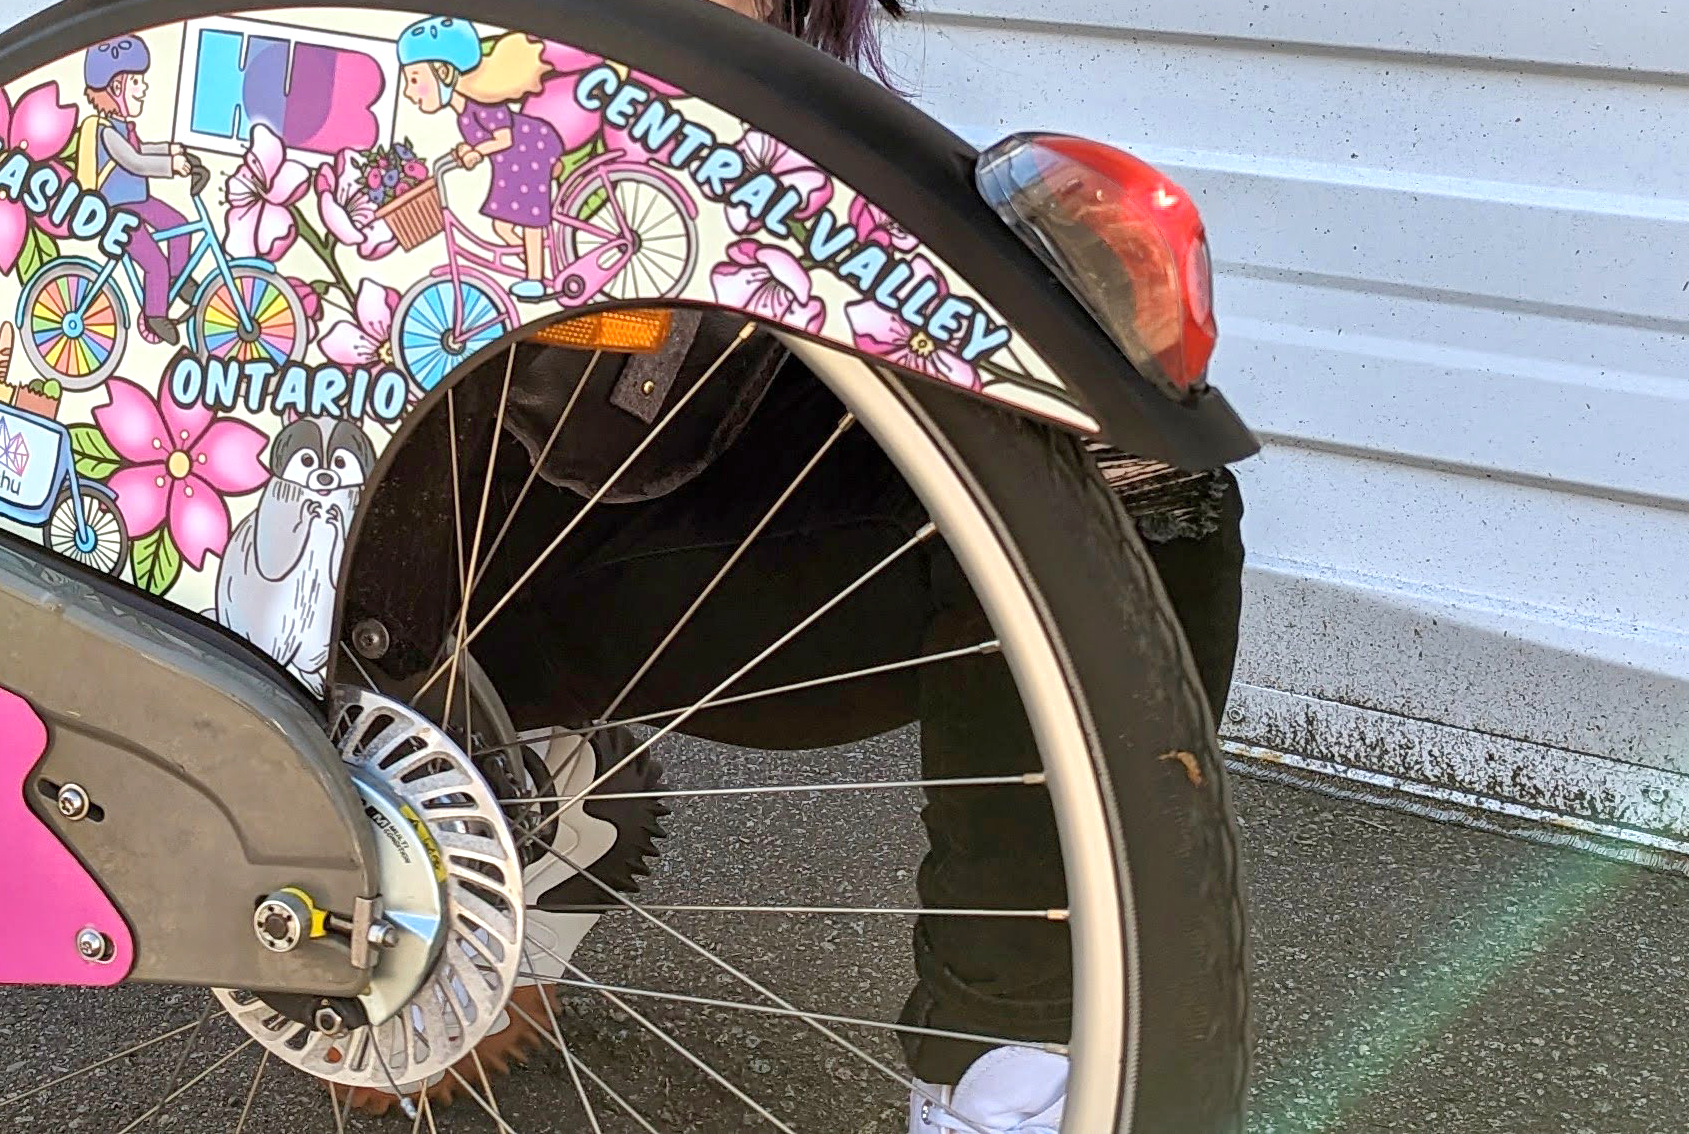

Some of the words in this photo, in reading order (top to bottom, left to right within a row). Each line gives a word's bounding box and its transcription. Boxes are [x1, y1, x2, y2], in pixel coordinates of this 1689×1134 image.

[189, 28, 386, 155] HUB
[576, 66, 801, 237] CENTRAL
[809, 210, 1011, 361] VALLEY
[172, 358, 407, 419] ONTARIO
